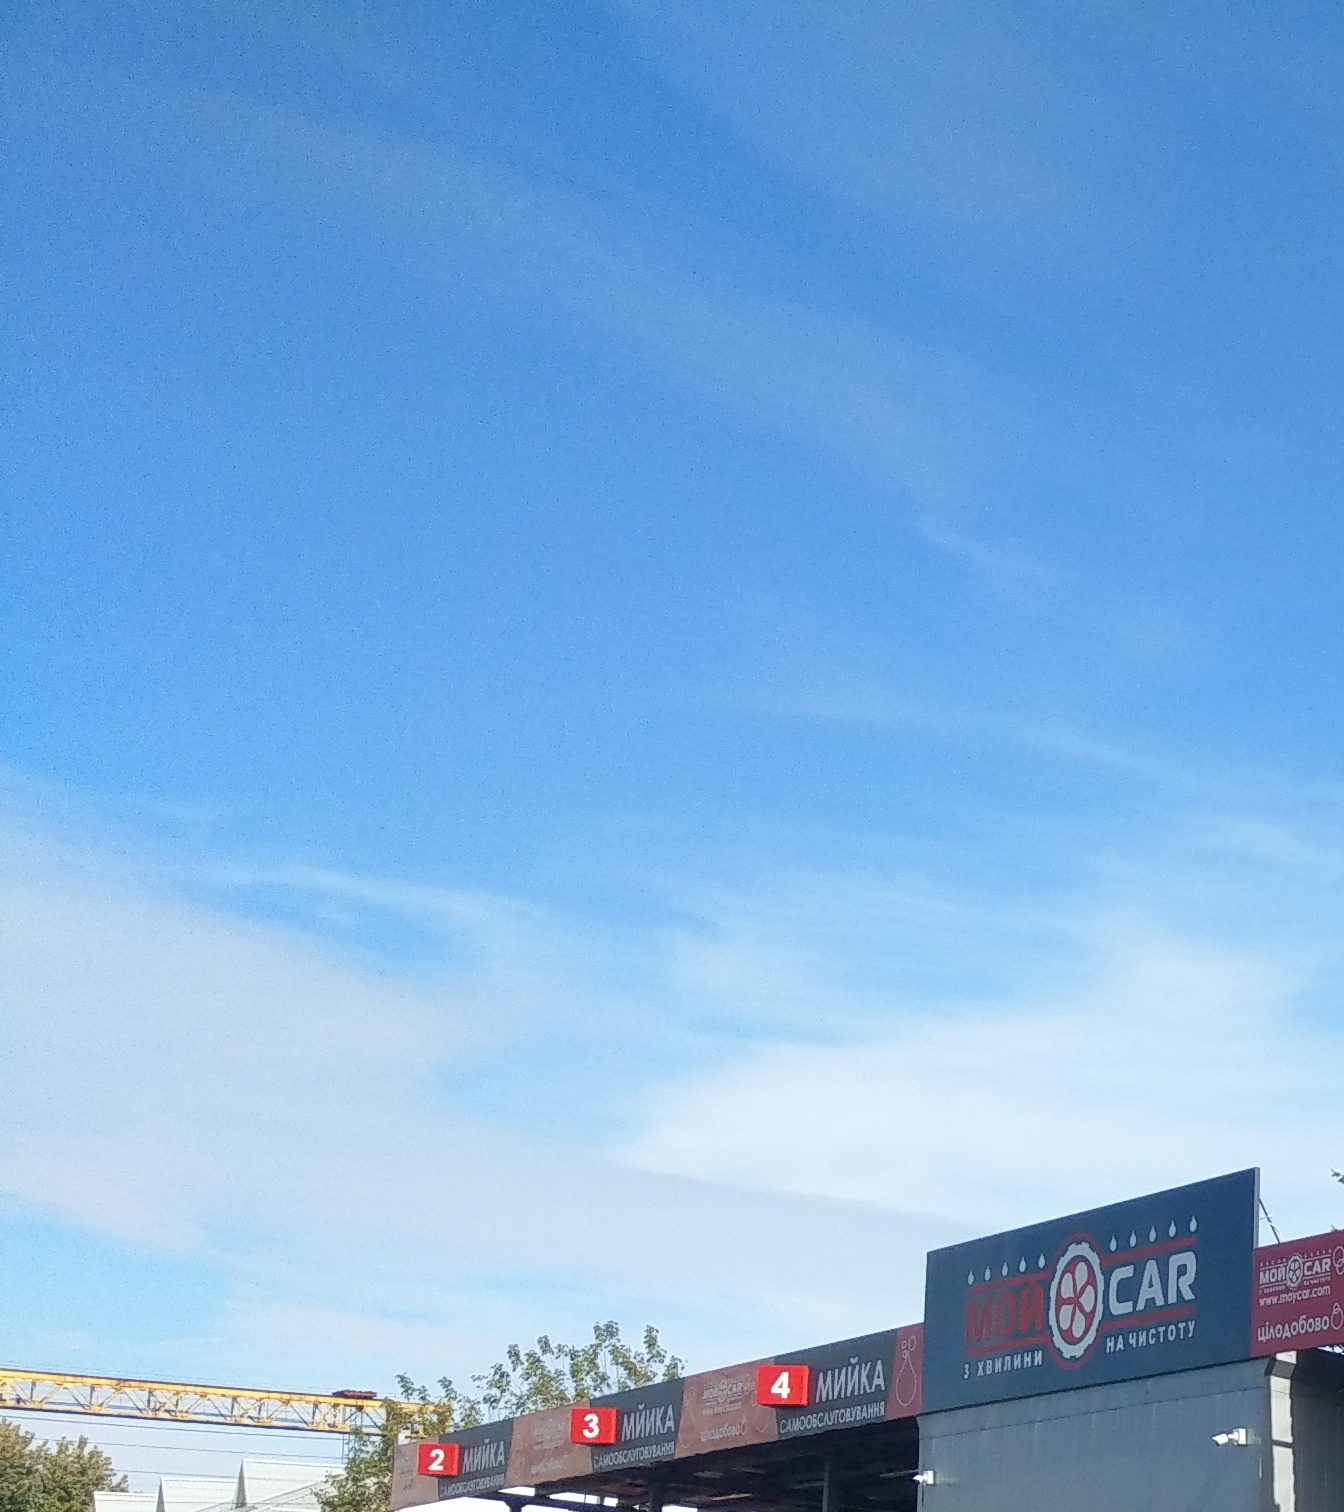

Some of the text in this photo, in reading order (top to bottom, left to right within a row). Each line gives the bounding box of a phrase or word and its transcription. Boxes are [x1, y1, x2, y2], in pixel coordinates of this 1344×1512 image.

[1260, 1265, 1286, 1285] МОЙ
[1304, 1258, 1331, 1276] CAR
[966, 1251, 1197, 1344] МОЙ CAR
[1259, 1285, 1331, 1307] www.moycar.com
[1257, 1315, 1330, 1343] цілодобово
[977, 1350, 1043, 1377] ХВИЛИНИ
[1106, 1336, 1125, 1353] НА
[1129, 1320, 1196, 1349] ЧИСТОТУ
[771, 1372, 791, 1398] 4
[816, 1356, 885, 1403] МИЙКА
[582, 1413, 600, 1438] 3
[779, 1401, 885, 1434] САМООБСЛУГОВУВАННЯ
[428, 1449, 444, 1471] 2
[462, 1438, 505, 1474] МИЙКА
